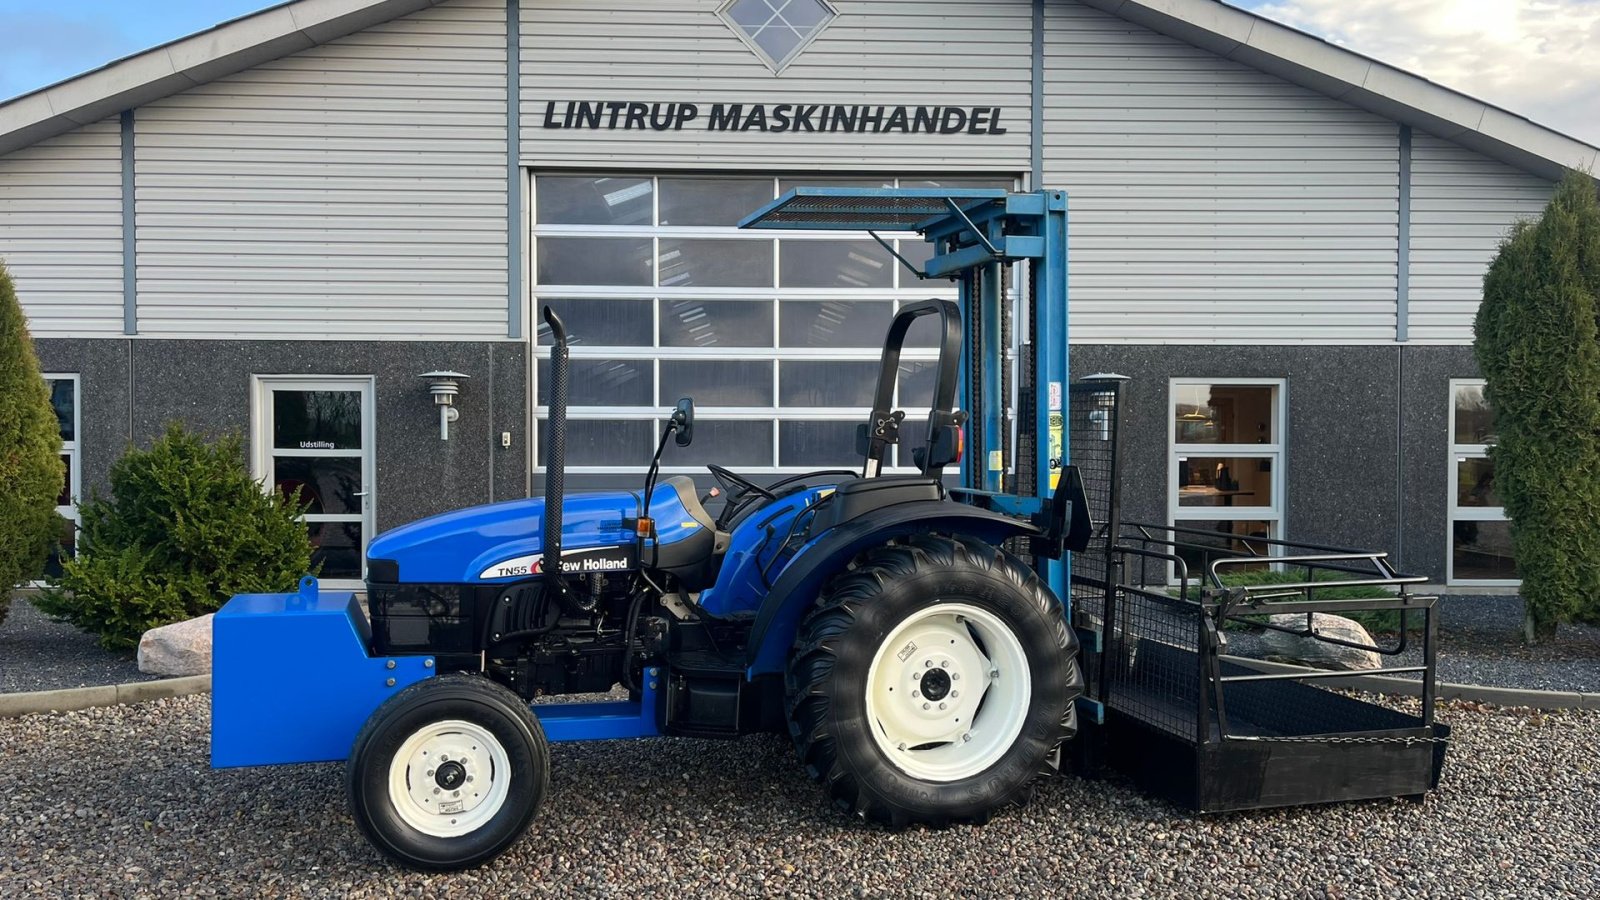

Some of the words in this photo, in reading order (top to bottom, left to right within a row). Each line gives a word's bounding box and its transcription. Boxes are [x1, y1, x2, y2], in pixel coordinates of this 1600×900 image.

[543, 101, 698, 131] LINTRUP
[707, 103, 1007, 135] MASKINHANDEL
[300, 441, 335, 449] Udstilling
[583, 558, 627, 570] Holland
[498, 566, 527, 576] TN55
